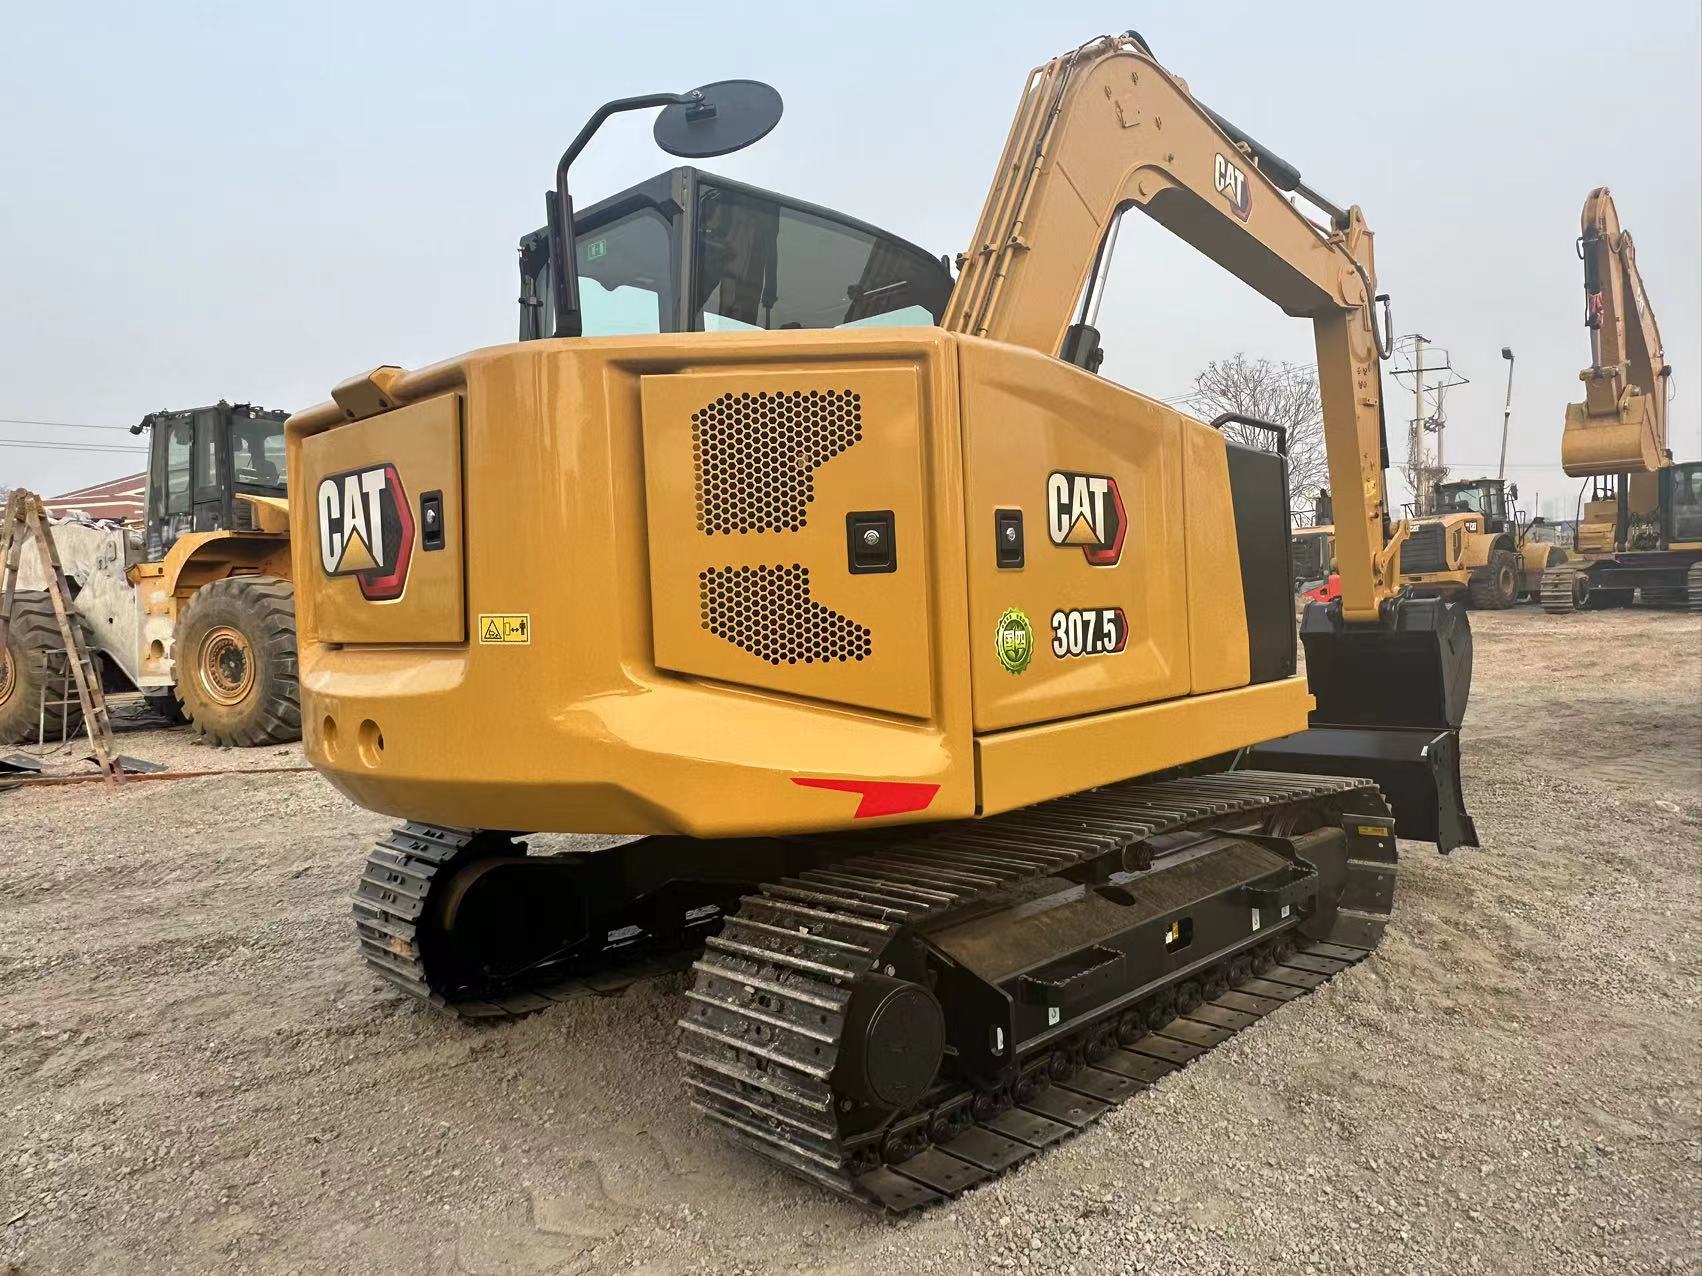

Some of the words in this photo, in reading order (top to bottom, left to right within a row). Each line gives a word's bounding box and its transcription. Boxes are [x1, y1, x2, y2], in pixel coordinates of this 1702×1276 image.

[1215, 153, 1244, 207] CAT
[319, 469, 386, 573] CAT
[1048, 474, 1107, 543] CAT
[1053, 611, 1116, 655] 307.5
